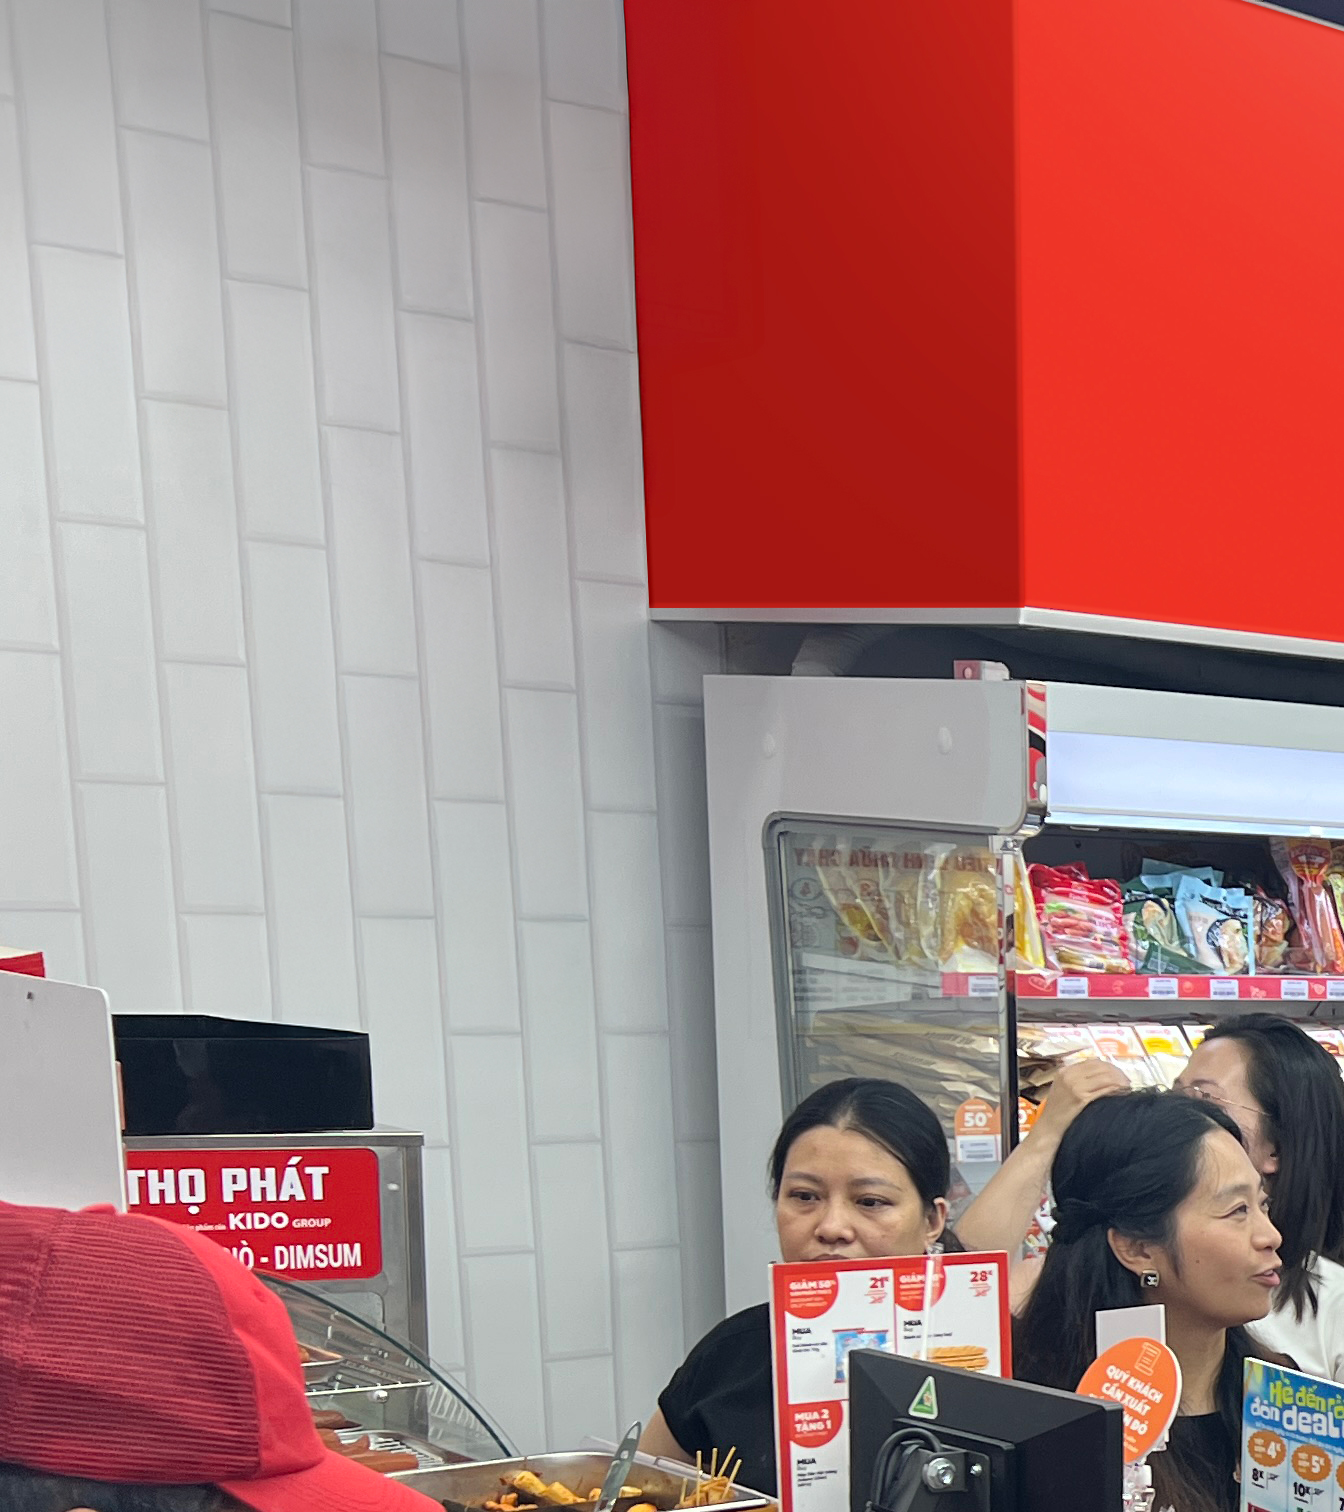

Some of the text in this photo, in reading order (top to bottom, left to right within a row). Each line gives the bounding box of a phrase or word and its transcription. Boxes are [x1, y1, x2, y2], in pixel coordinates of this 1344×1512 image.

[127, 1156, 329, 1215] THỌ PHÁT
[229, 1212, 332, 1231] KIDO GROUP
[274, 1243, 361, 1270] DIMSUM
[1101, 1382, 1151, 1416] CẦN XUẤT
[1106, 1365, 1163, 1403] QUÝ KHÁCH
[1270, 1376, 1294, 1408] Hè
[1296, 1385, 1326, 1412] đến
[794, 1409, 830, 1422] MUA 2
[795, 1420, 832, 1434] TẶNG 1
[1250, 1396, 1280, 1421] đón
[1282, 1406, 1340, 1439] deal
